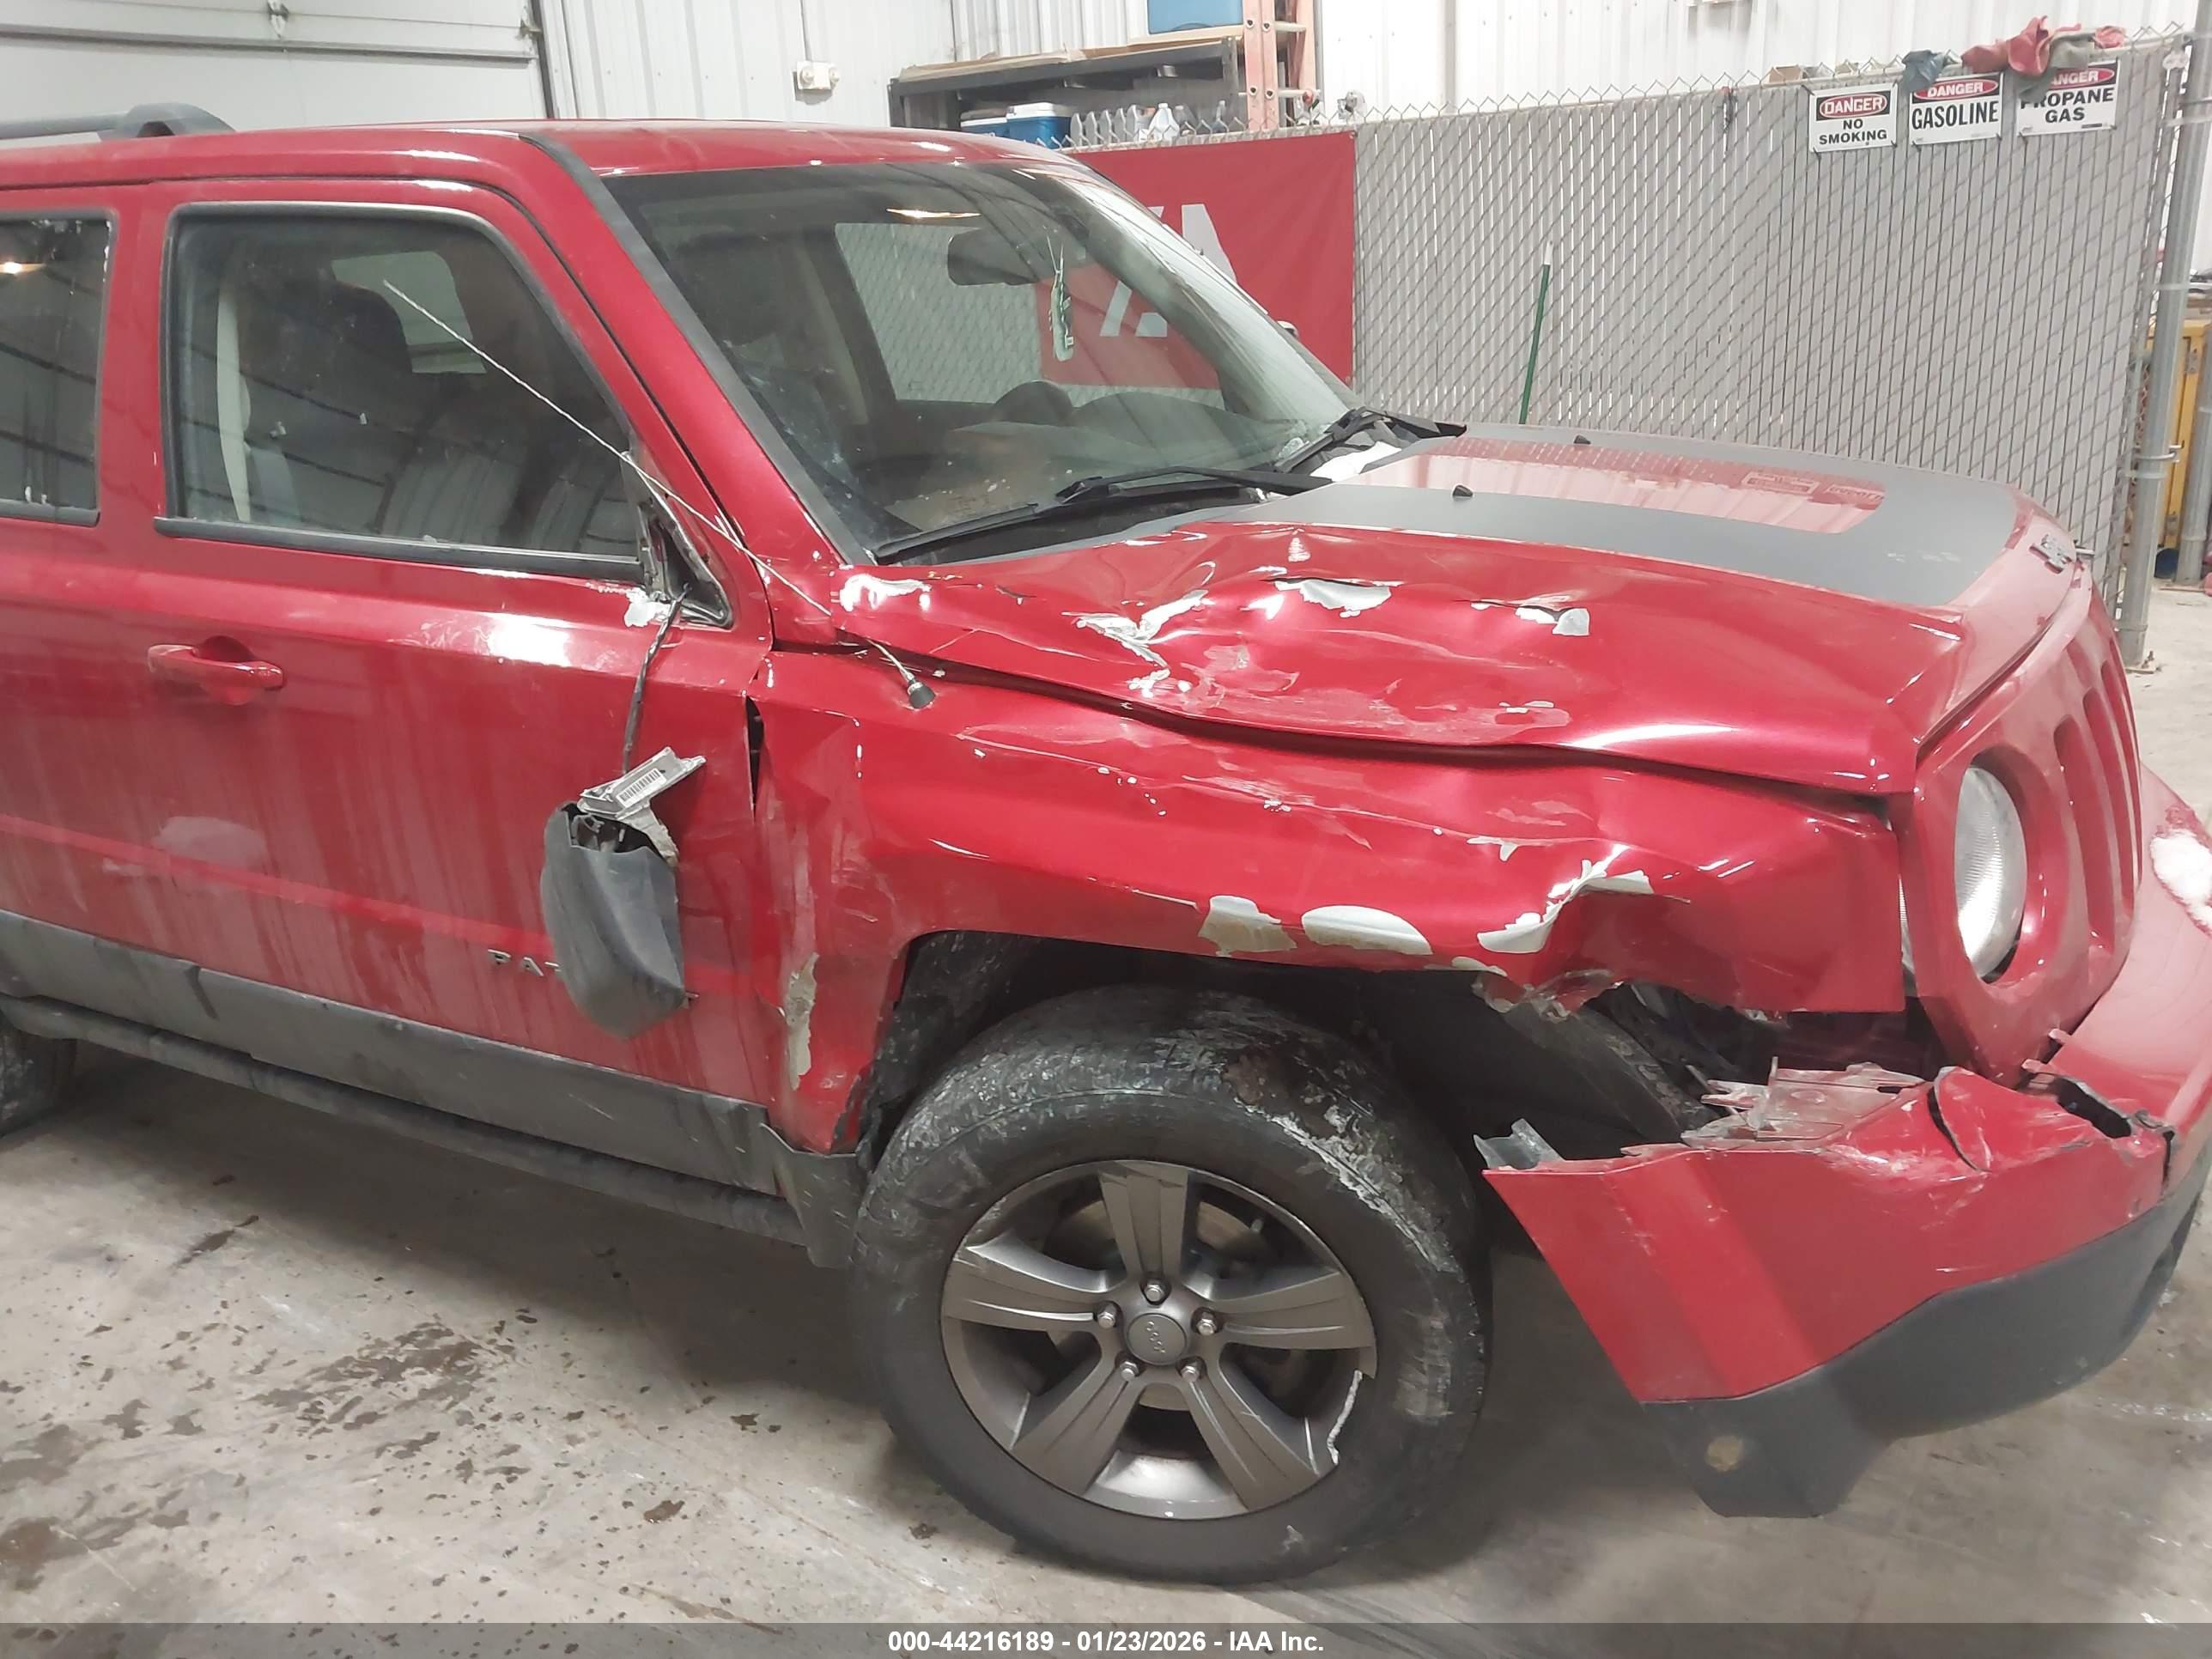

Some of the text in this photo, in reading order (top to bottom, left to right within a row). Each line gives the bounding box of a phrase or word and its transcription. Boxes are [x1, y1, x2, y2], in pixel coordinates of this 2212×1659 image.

[2050, 70, 2100, 85] ANGER
[1927, 82, 1984, 97] DANGER
[1824, 96, 1883, 114] DANGER
[1911, 100, 1999, 130] GASOLINE
[2045, 106, 2085, 124] GAS
[1843, 118, 1863, 130] NO
[1819, 129, 1887, 145] SMOKING
